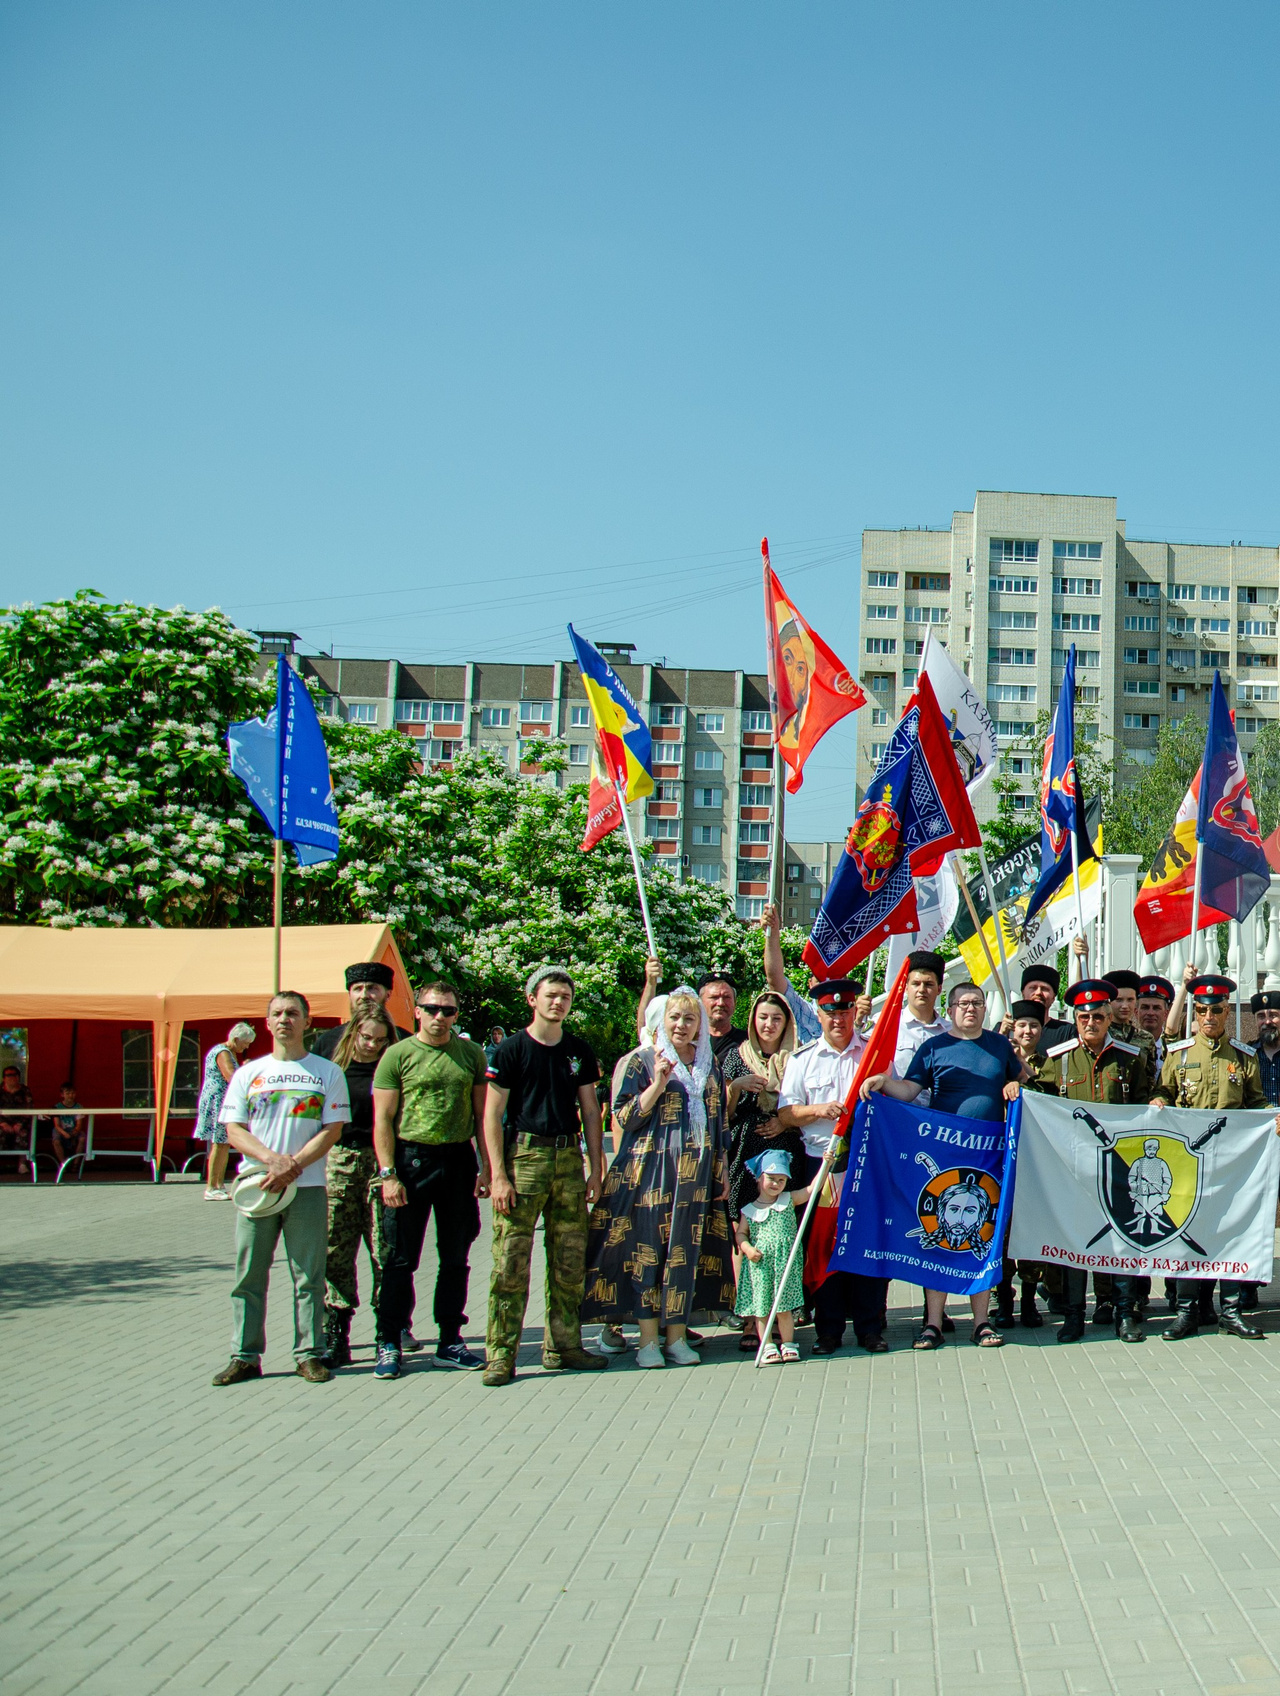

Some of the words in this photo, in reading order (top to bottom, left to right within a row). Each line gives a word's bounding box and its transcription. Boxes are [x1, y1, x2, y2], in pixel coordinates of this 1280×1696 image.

[267, 1075, 323, 1086] GARDENA
[851, 1104, 874, 1193] КАЗАЧИЙ
[934, 1126, 995, 1151] НАМИ
[837, 1207, 855, 1256] СПАС
[863, 1249, 921, 1267] КАЗАЧЕСТВО
[1041, 1244, 1149, 1269] ВОРОНЕЖСКОЕ
[1152, 1257, 1250, 1275] КАЗАЧЕСТВО
